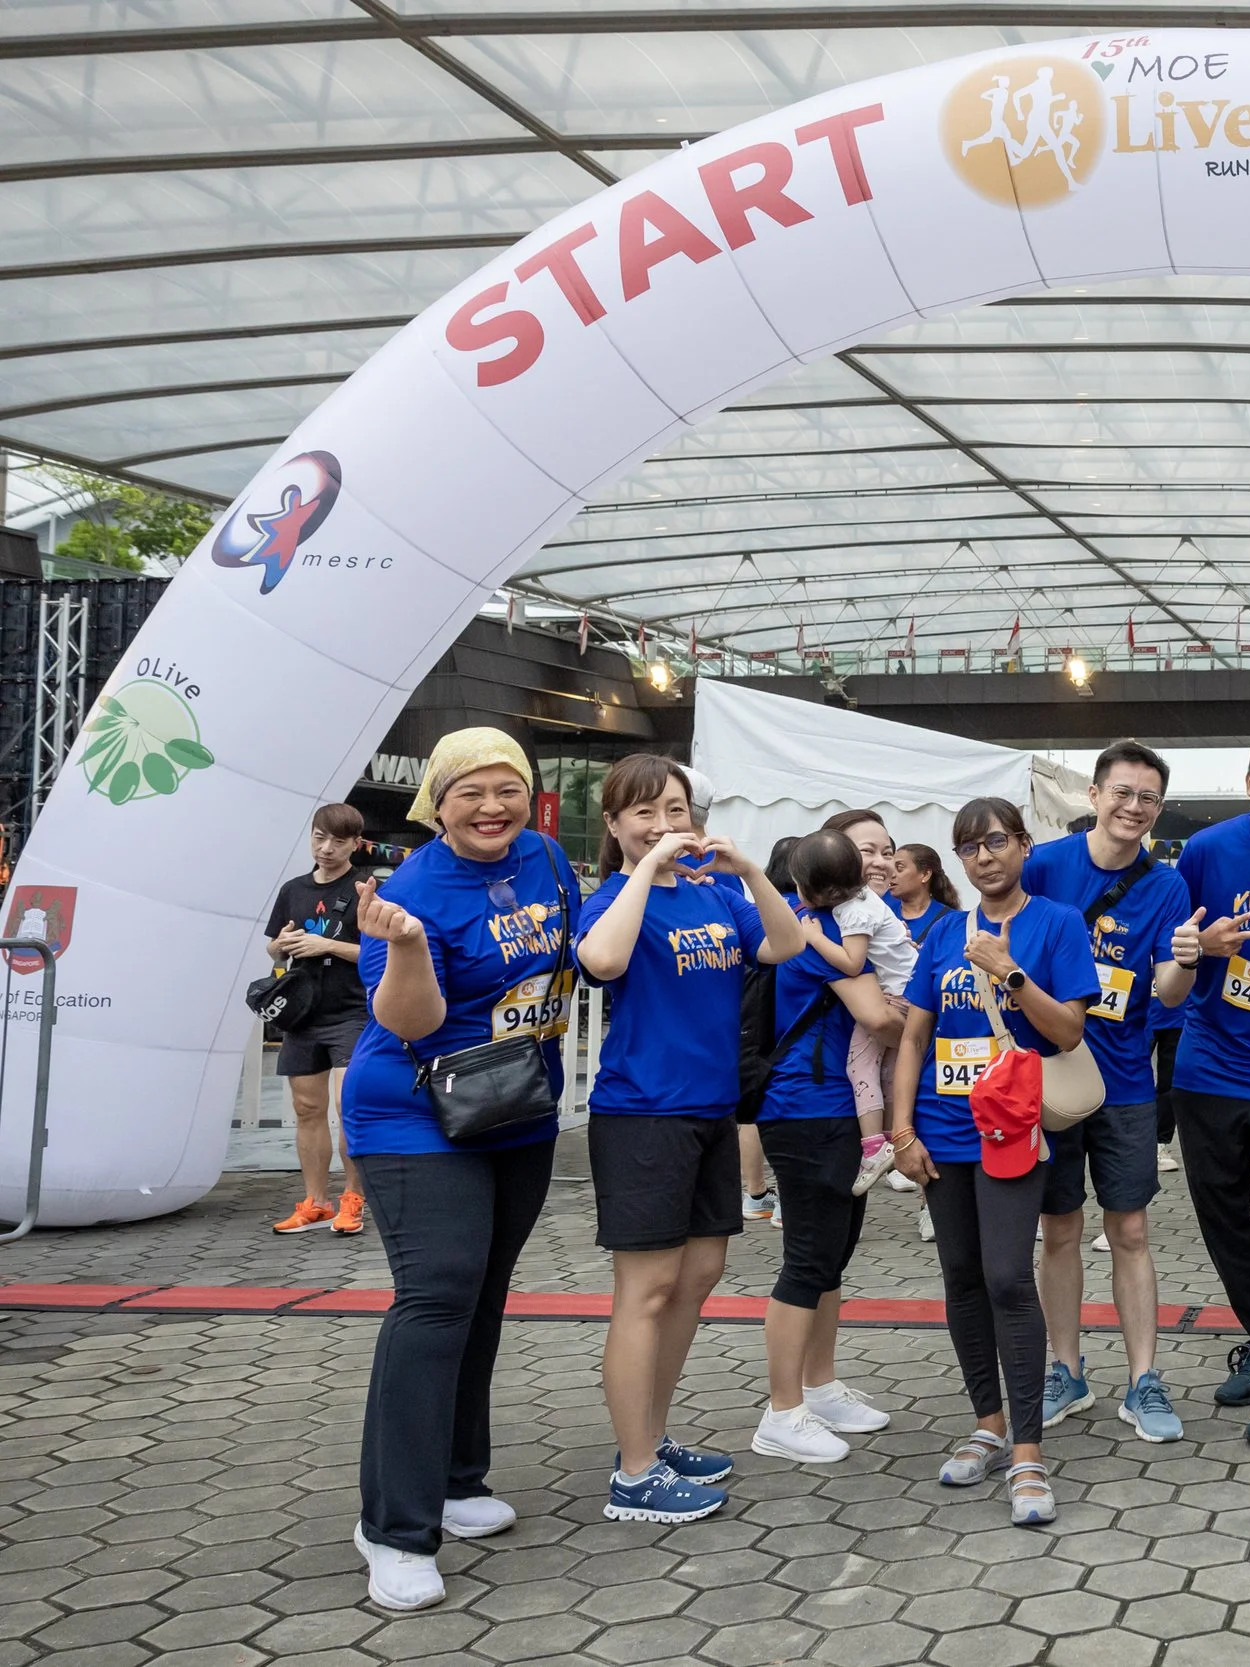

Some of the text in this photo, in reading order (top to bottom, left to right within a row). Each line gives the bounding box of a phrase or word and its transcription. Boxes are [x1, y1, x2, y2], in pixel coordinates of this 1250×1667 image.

[1082, 35, 1151, 60] 15th
[1128, 52, 1229, 83] MOE
[1205, 159, 1250, 177] RUN
[445, 102, 885, 387] START
[302, 554, 393, 569] mesrc
[676, 940, 742, 976] RUNNING
[24, 991, 111, 1008] Edcation
